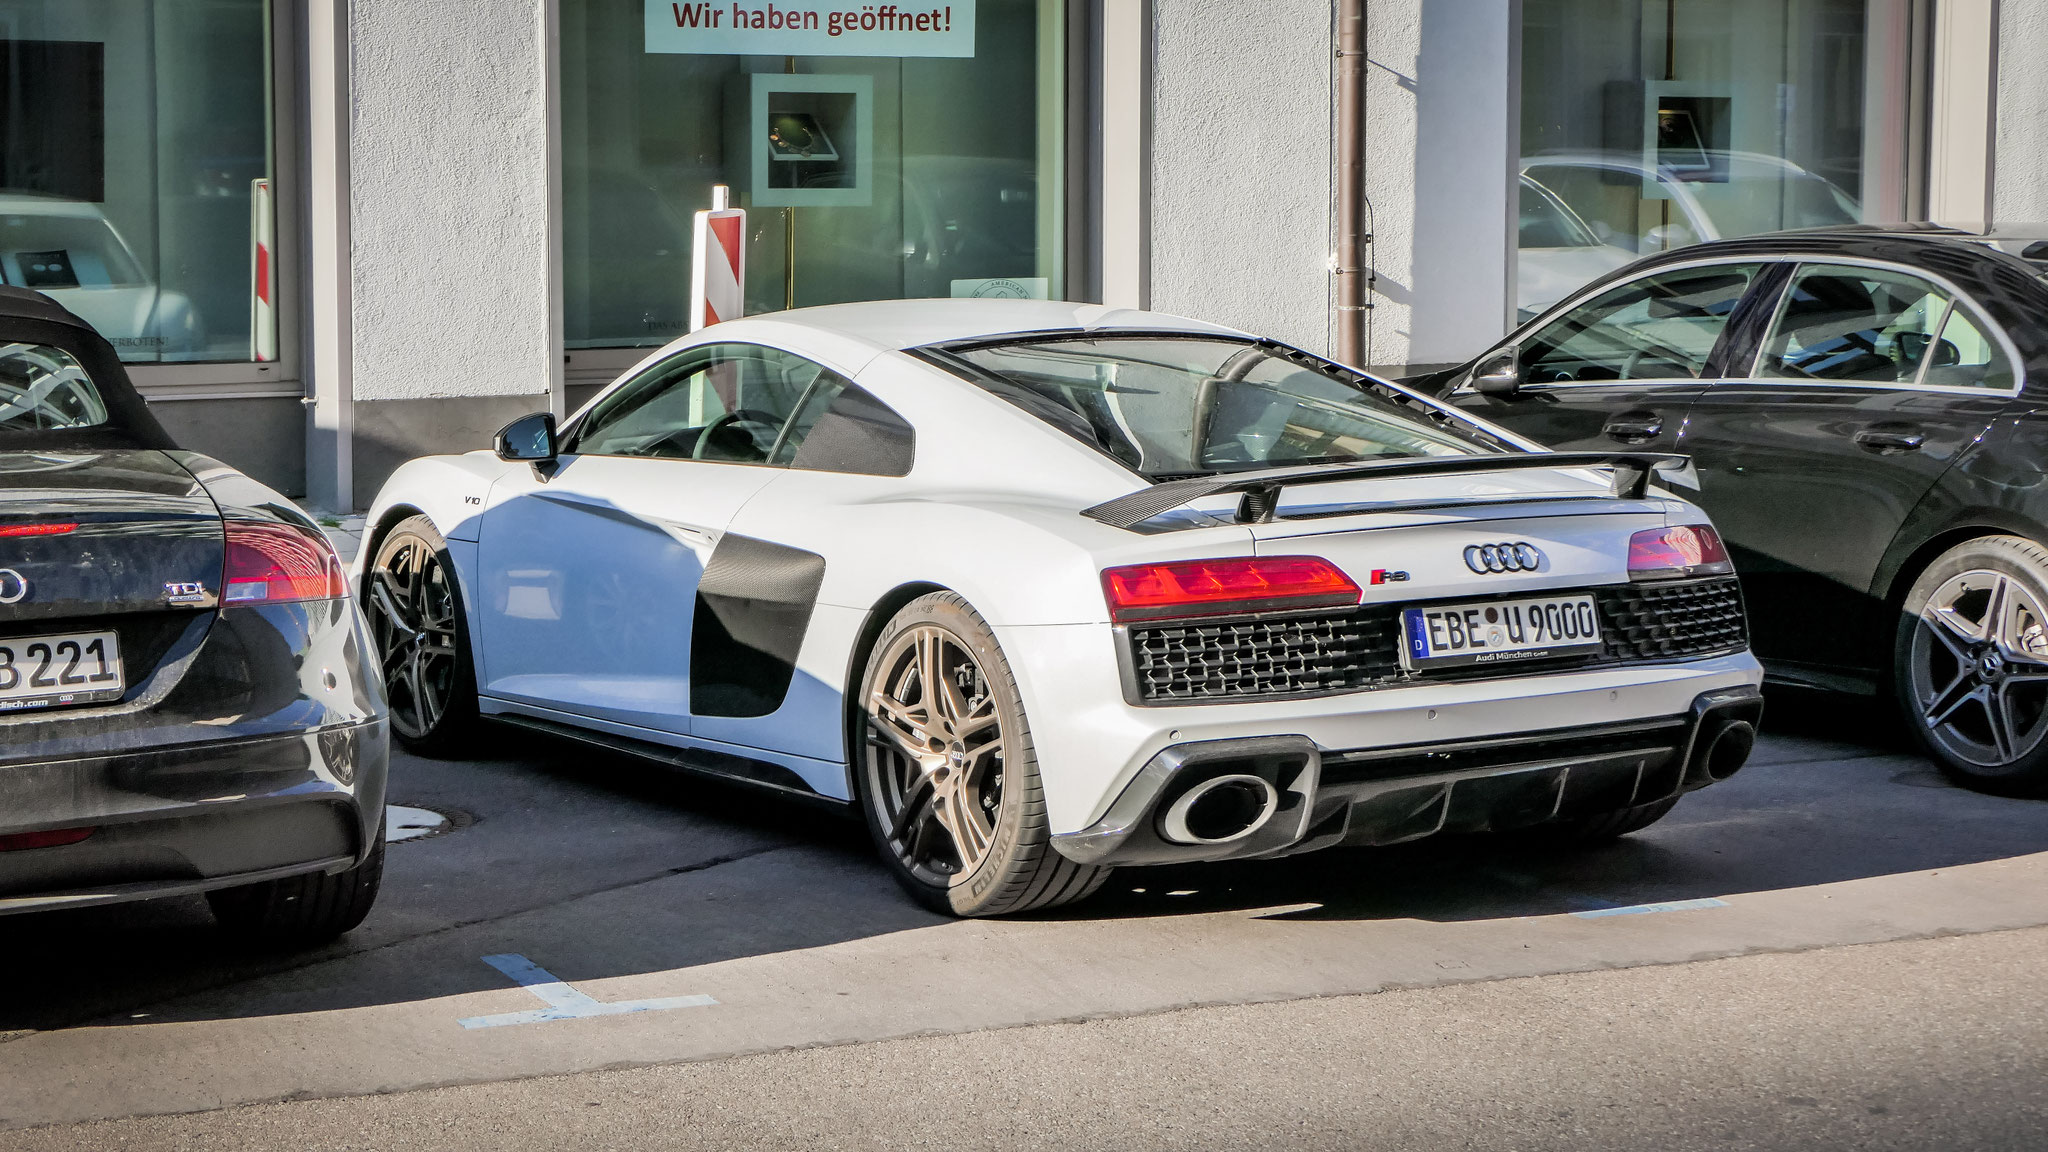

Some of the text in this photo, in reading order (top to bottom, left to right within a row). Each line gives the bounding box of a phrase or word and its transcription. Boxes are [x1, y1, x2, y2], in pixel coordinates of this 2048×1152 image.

[673, 2, 951, 37] Wir haben geöffnet!
[465, 496, 480, 505] V10
[165, 581, 204, 596] TDI
[1426, 601, 1595, 652] EBE U 9000
[1415, 640, 1424, 651] D
[27, 637, 114, 689] 221
[1475, 654, 1496, 662] Audi
[1496, 651, 1533, 661] München
